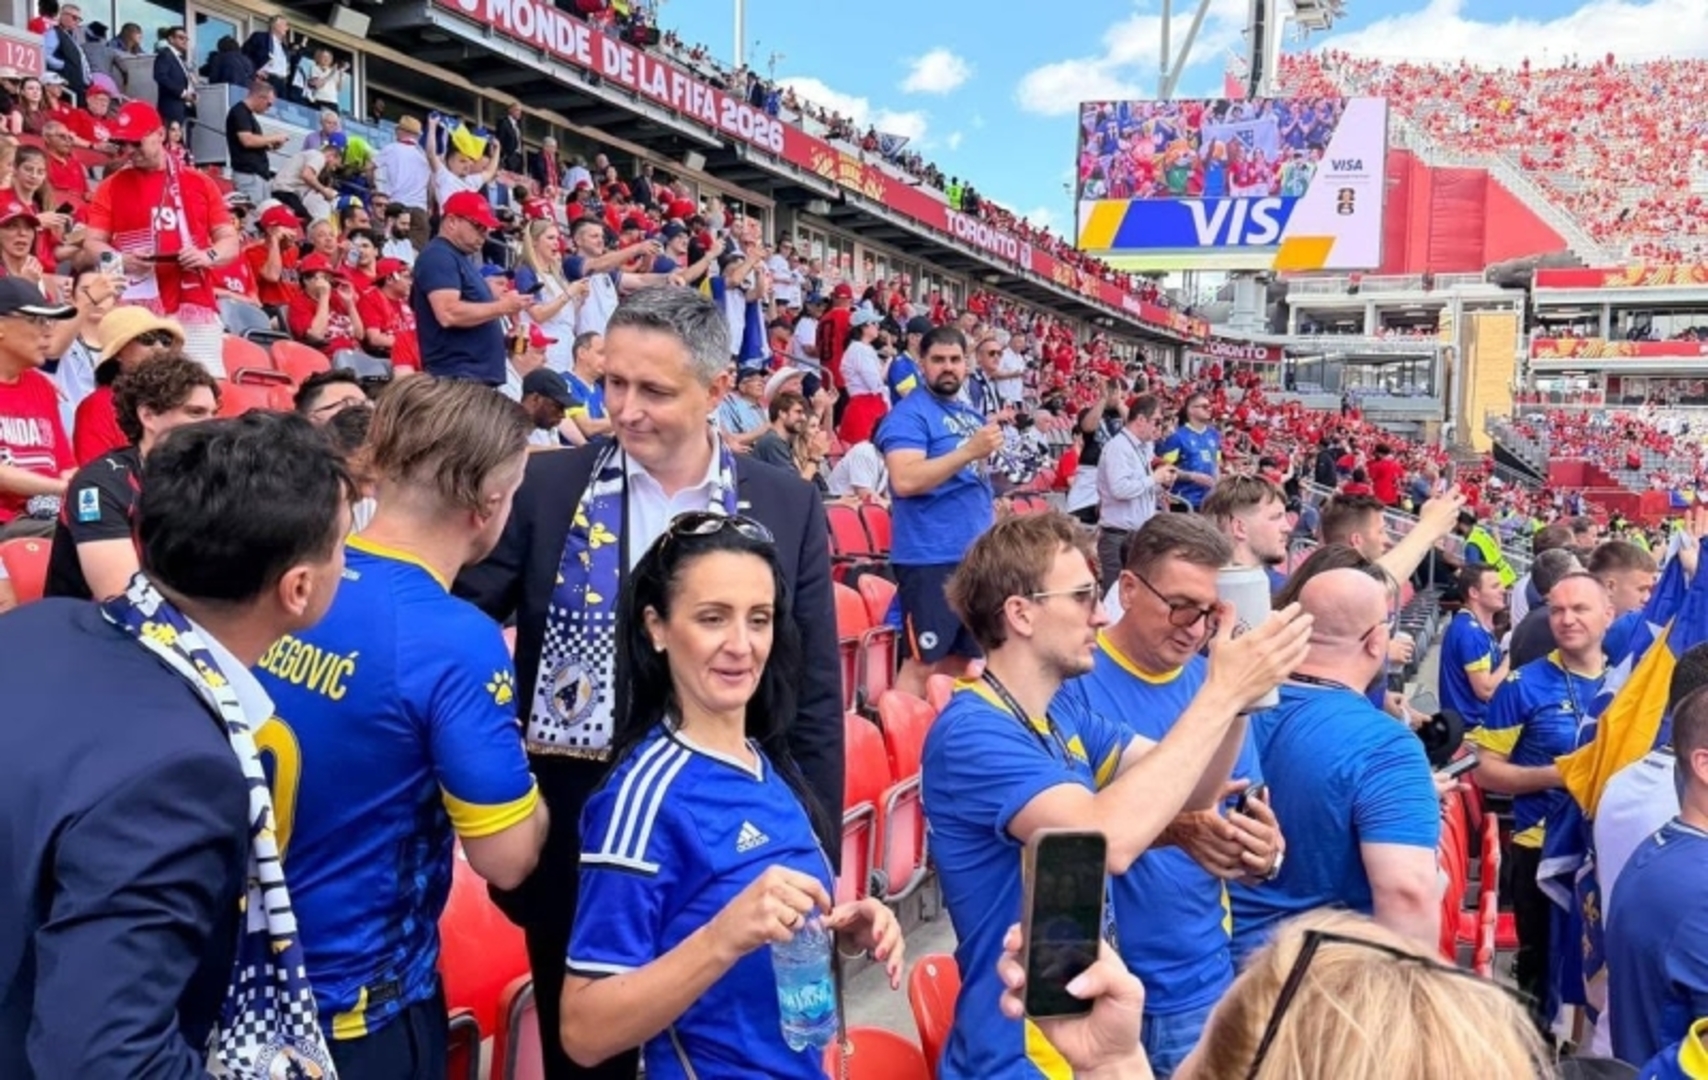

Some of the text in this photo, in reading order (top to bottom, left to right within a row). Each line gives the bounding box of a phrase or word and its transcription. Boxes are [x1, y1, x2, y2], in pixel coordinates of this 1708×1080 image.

[6, 41, 37, 71] 122
[486, 0, 785, 152] MONDE DE LA FIFA 2026
[1331, 158, 1363, 171] VISA
[945, 207, 1018, 259] TORONTO
[1204, 342, 1268, 359] ORONTO
